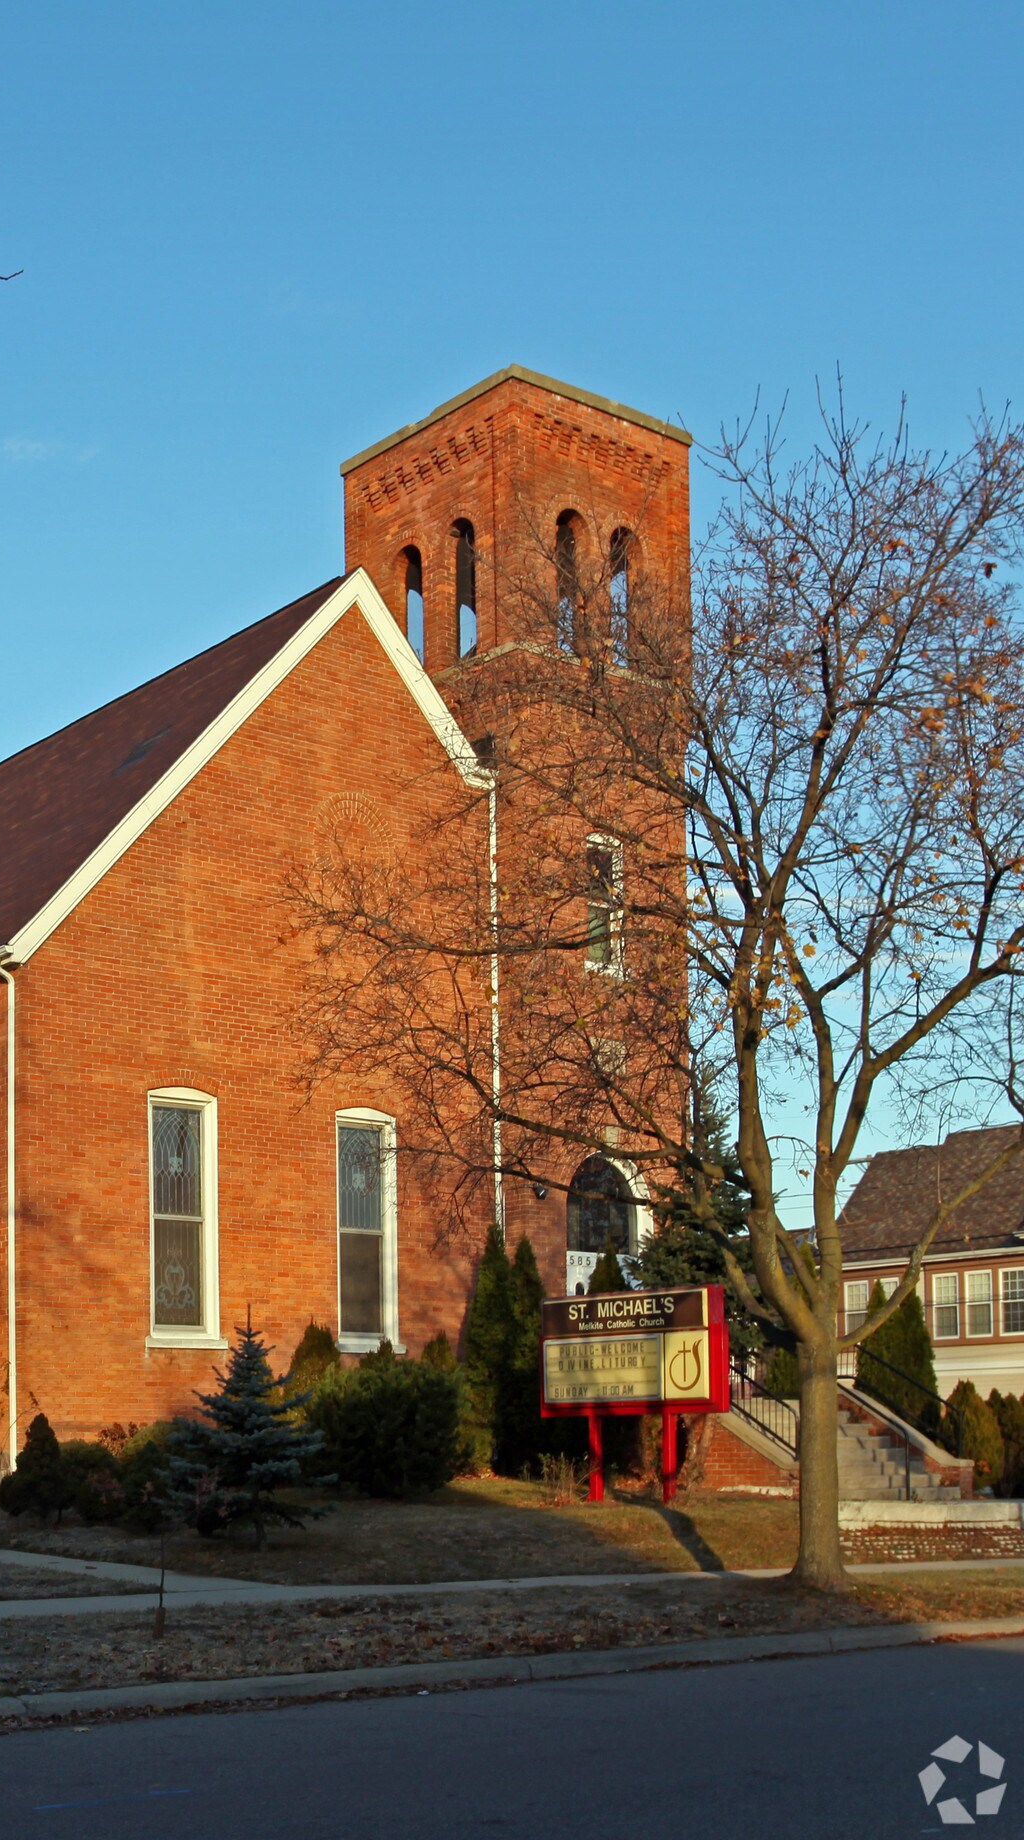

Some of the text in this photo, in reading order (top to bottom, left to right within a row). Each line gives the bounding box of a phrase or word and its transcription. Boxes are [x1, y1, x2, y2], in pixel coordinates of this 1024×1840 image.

[569, 1255, 591, 1266] 585
[568, 1297, 675, 1320] ST. MICHAEL'S
[578, 1317, 665, 1331] Melkite Catholic Church
[554, 1386, 588, 1398] SUNDAY
[622, 1385, 634, 1395] AM
